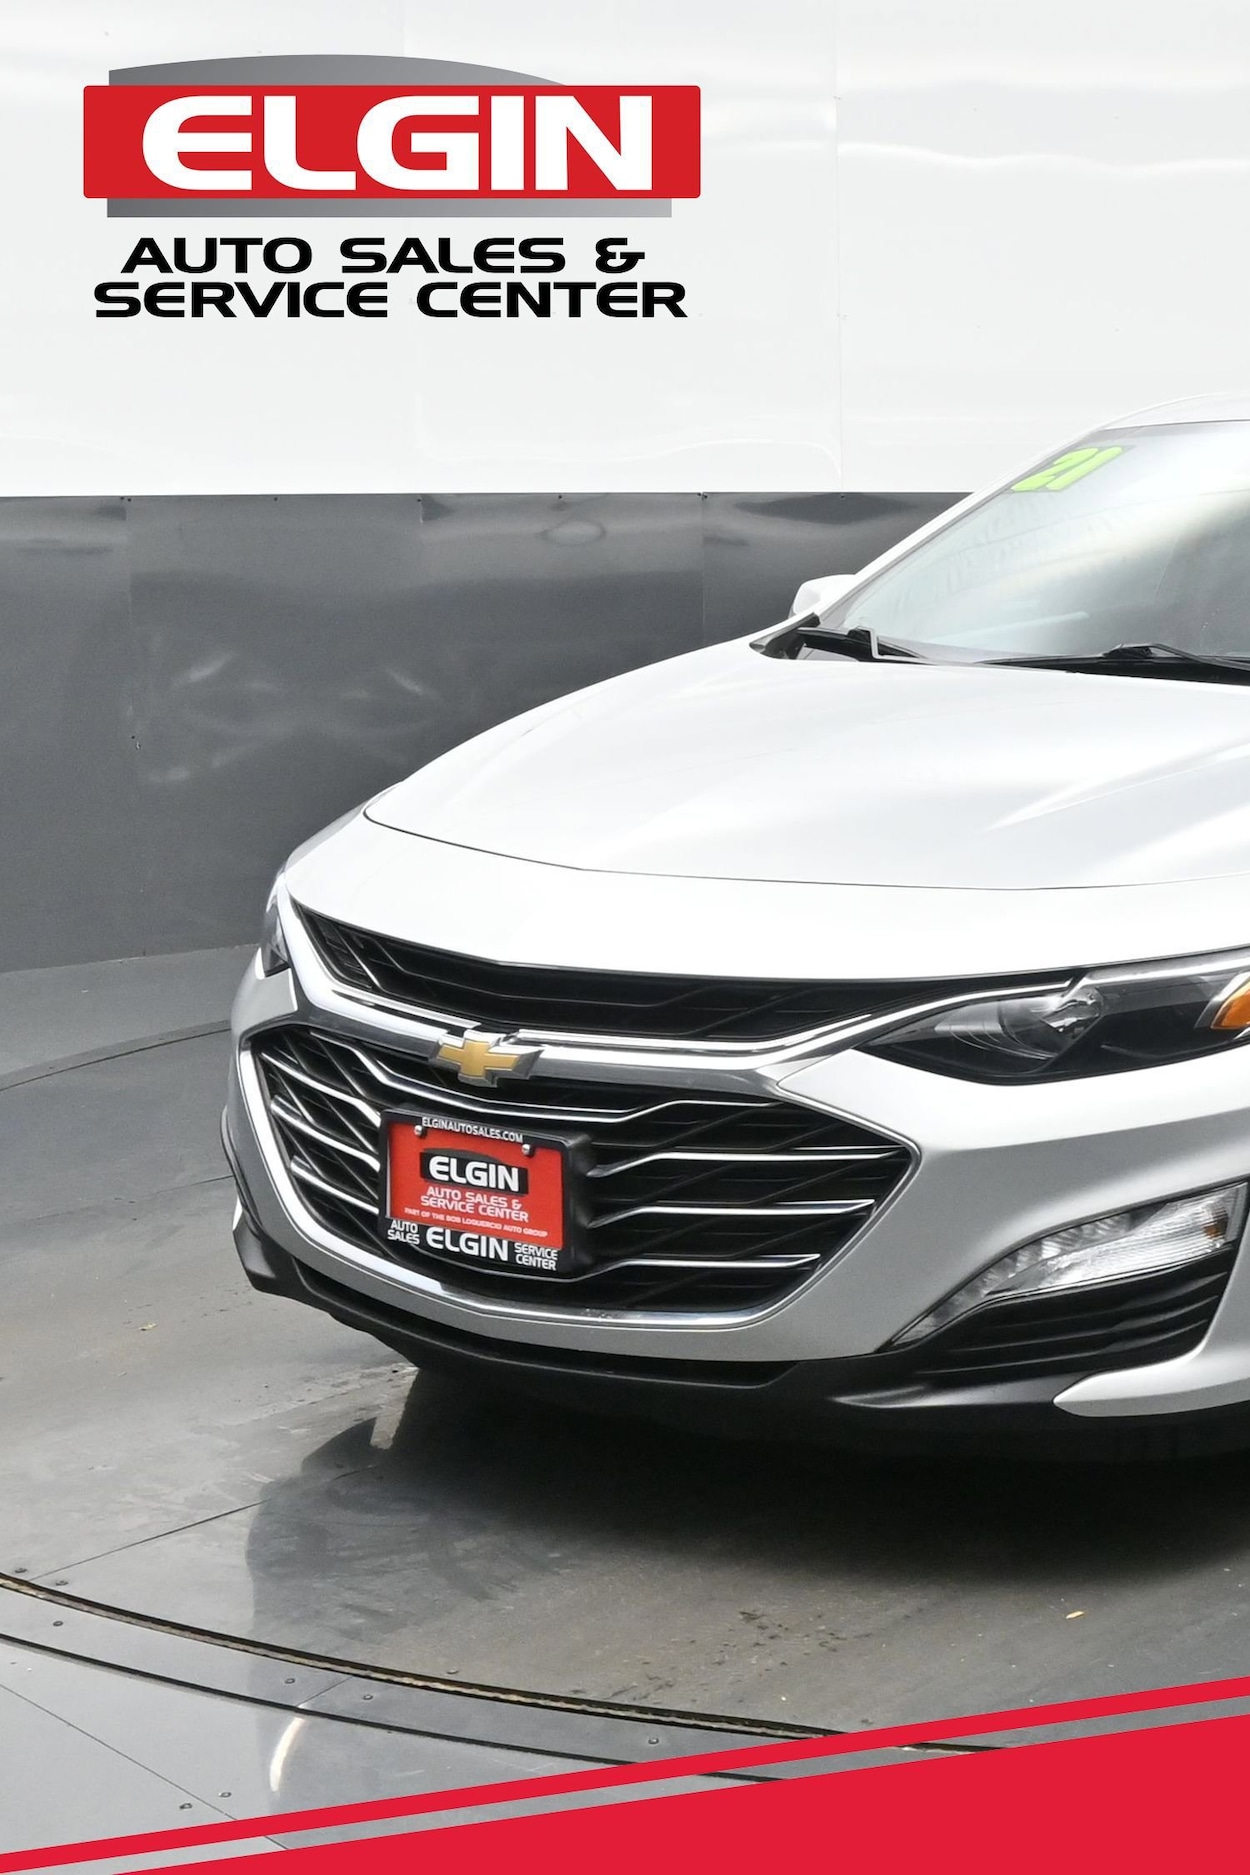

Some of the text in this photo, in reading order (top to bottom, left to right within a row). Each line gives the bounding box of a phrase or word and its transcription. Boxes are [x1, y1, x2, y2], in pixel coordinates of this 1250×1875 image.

[1010, 446, 1123, 492] 21
[421, 1116, 524, 1143] ELGINAUTOSALES.COM
[428, 1155, 520, 1192] ELGIN
[420, 1195, 529, 1223] SERVICE CENTER
[426, 1186, 522, 1211] AUTO SALES &
[387, 1229, 420, 1245] SALES
[390, 1219, 418, 1234] AUTO
[432, 1212, 445, 1221] THE
[503, 1225, 522, 1234] AUTO
[523, 1227, 548, 1238] GROUP
[426, 1226, 509, 1261] ELGIN
[514, 1242, 558, 1260] SERVICE
[515, 1253, 557, 1271] CENTER
